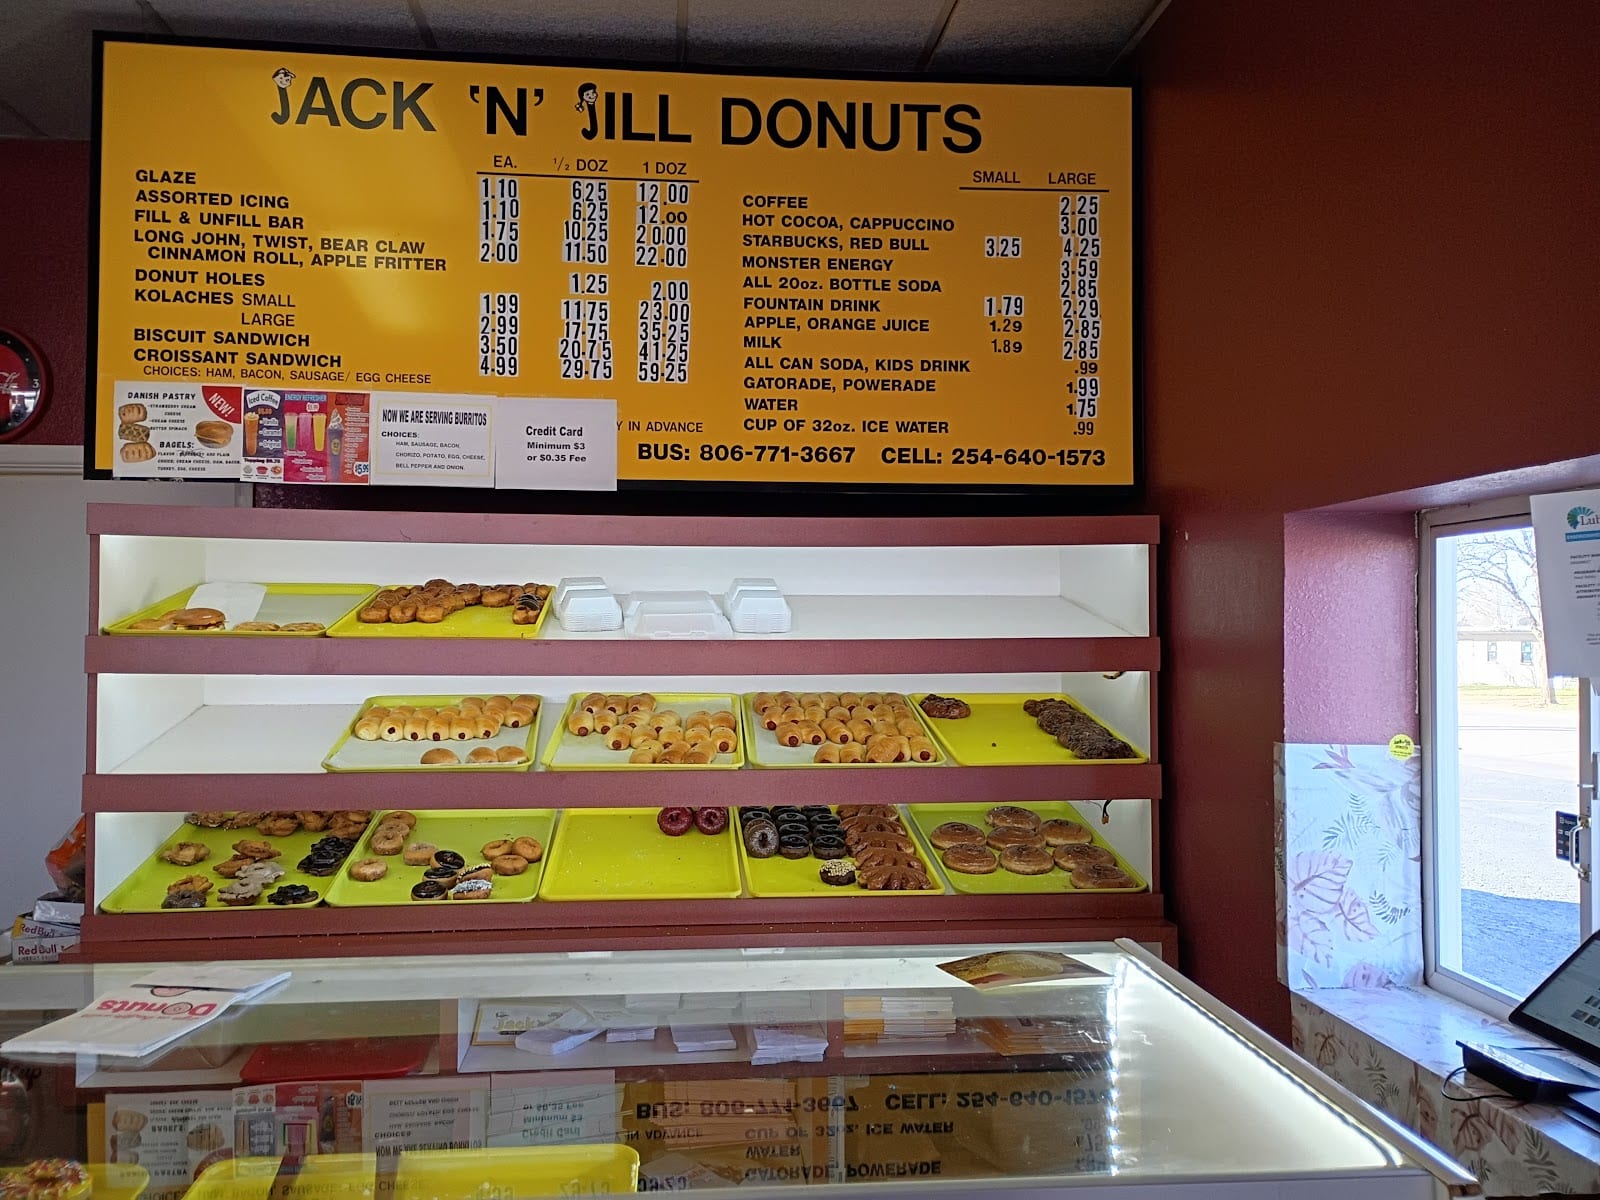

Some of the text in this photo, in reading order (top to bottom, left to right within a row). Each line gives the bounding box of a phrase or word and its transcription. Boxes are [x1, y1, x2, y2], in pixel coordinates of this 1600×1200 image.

[271, 67, 436, 131] JACK
[575, 83, 692, 143] JILL
[722, 97, 982, 154] DONUTS
[494, 155, 517, 168] EA.
[577, 159, 608, 172] DOZ
[643, 161, 687, 175] 1 DOZ
[136, 169, 196, 184] GLAZE
[973, 170, 1020, 183] SMALL
[1049, 172, 1096, 185] LARGE
[482, 178, 517, 198] 1.10
[136, 189, 289, 209] ASSORTED ICING
[743, 195, 808, 209] COFFEE
[1060, 196, 1098, 215] 2.25
[135, 209, 303, 229] FILL & UNFILL BAR
[483, 200, 518, 220] 1.10
[572, 202, 608, 221] 6.25
[482, 222, 518, 240] 1.75
[564, 221, 608, 241] 10.25
[743, 214, 954, 231] HOT COCOA, CAPPUCCINO
[1061, 217, 1097, 236] 3.00
[134, 229, 425, 254] LONG JOHN, TWIST, BEAR CLAW
[743, 234, 929, 251] STARBUCKS, RED BULL
[986, 238, 1020, 256] 3.25
[1064, 238, 1100, 257] 4.25
[148, 246, 446, 271] CINNAMON ROLL, APPLE FRITTER
[481, 243, 518, 262] 2.00
[565, 243, 607, 263] 11.50
[636, 247, 686, 266] 22.00
[742, 256, 893, 271] MONSTER ENERGY
[1062, 259, 1097, 279] 3.59
[135, 269, 265, 286] DONUT HOLES
[572, 274, 607, 294] 1.25
[743, 276, 941, 292] ALL 20oz. BOTTLE SODA
[135, 289, 295, 307] KOLACHES SMALL
[653, 282, 688, 301] 2.00
[1061, 280, 1097, 298] 2.85
[484, 295, 518, 314] 1.99
[564, 301, 607, 321] 11.75
[639, 301, 689, 321] 23.00
[744, 297, 880, 312] FOUNTAIN DRINK
[986, 296, 1023, 316] 1.79
[241, 312, 295, 327] LARGE
[481, 316, 518, 335] 2.99
[744, 316, 929, 332] APPLE, ORANGE JUICE
[990, 318, 1022, 332] 1.29
[134, 328, 309, 347] BISCUIT SANDWICH
[1065, 320, 1099, 338] 2.85
[480, 335, 517, 355] 3.50
[744, 336, 781, 348] MILK
[991, 339, 1022, 353] 1.89
[1064, 341, 1097, 359] 2.85
[134, 348, 341, 367] CROISSANT SANDWICH
[480, 356, 518, 375] 4.99
[744, 356, 970, 373] ALL CAN SODA, KIDS DRINK
[143, 365, 201, 377] CHOICES:
[206, 368, 235, 379] HAM,
[241, 369, 284, 380] BACON,
[356, 372, 380, 382] EGG
[385, 373, 431, 384] CHEESE
[562, 360, 612, 378] 29.75
[639, 362, 687, 381] 59.25
[1075, 361, 1098, 375] .99
[744, 377, 936, 392] GATORADE, POWERADE
[1067, 378, 1098, 396] 1.99
[208, 393, 236, 418] NEW!
[248, 395, 260, 405] Iced
[744, 398, 798, 411] WATER
[1067, 399, 1096, 417] 1.75
[382, 409, 487, 426] NOW WE ARE SERVING BURRITOS
[629, 421, 640, 431] IN
[646, 421, 703, 432] ADVANCE
[744, 418, 948, 433] CUP OF 32oz. ICE WATER
[526, 426, 583, 437] Credit Card
[1073, 421, 1094, 435] .99
[574, 442, 585, 450] $3
[638, 443, 855, 463] BUS: 806-771-3667
[540, 454, 566, 462] $0.35
[569, 454, 586, 462] Fee
[881, 447, 1105, 466] CELL: 254-640-1573
